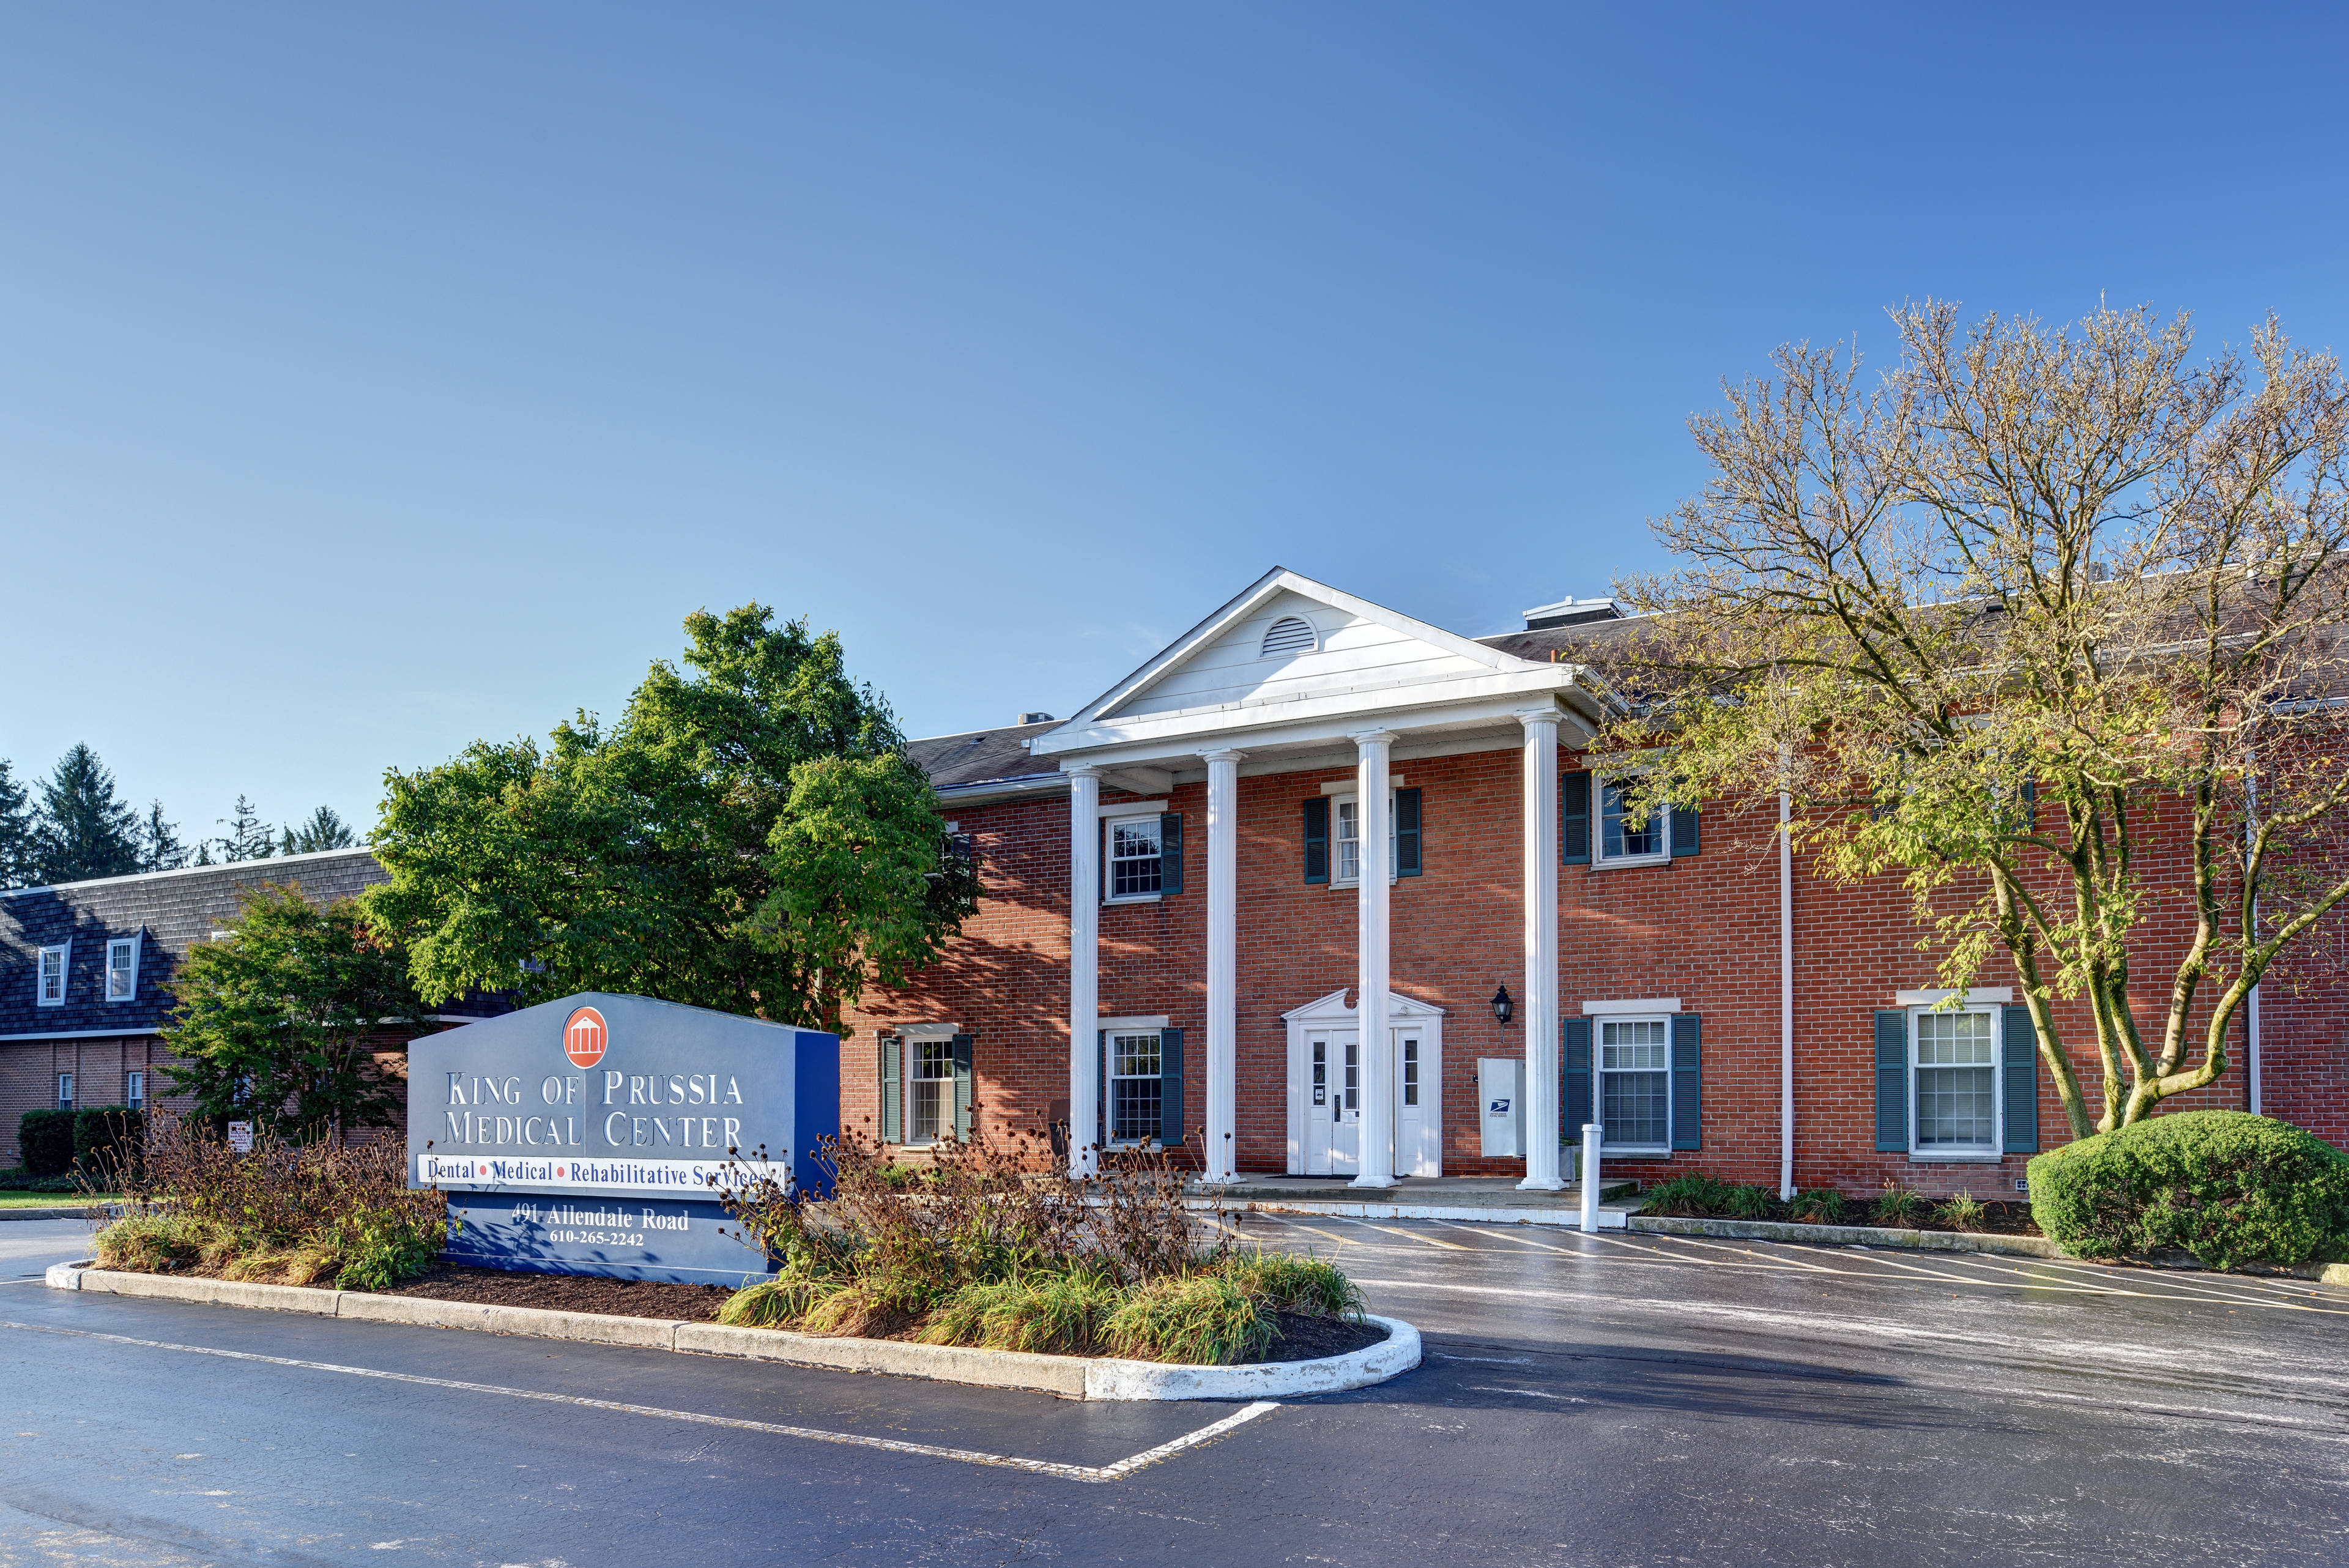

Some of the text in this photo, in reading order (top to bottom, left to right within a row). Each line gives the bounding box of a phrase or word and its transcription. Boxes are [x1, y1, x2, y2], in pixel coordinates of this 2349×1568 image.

[445, 1069, 744, 1105] KING OF PRUSSIA
[443, 1110, 743, 1148] MEDICAL CENTER
[427, 1160, 766, 1187] Dental Medical Rehabilitative Services
[511, 1202, 689, 1231] 491 Allendale Road
[550, 1230, 644, 1247] 610-265-2242
